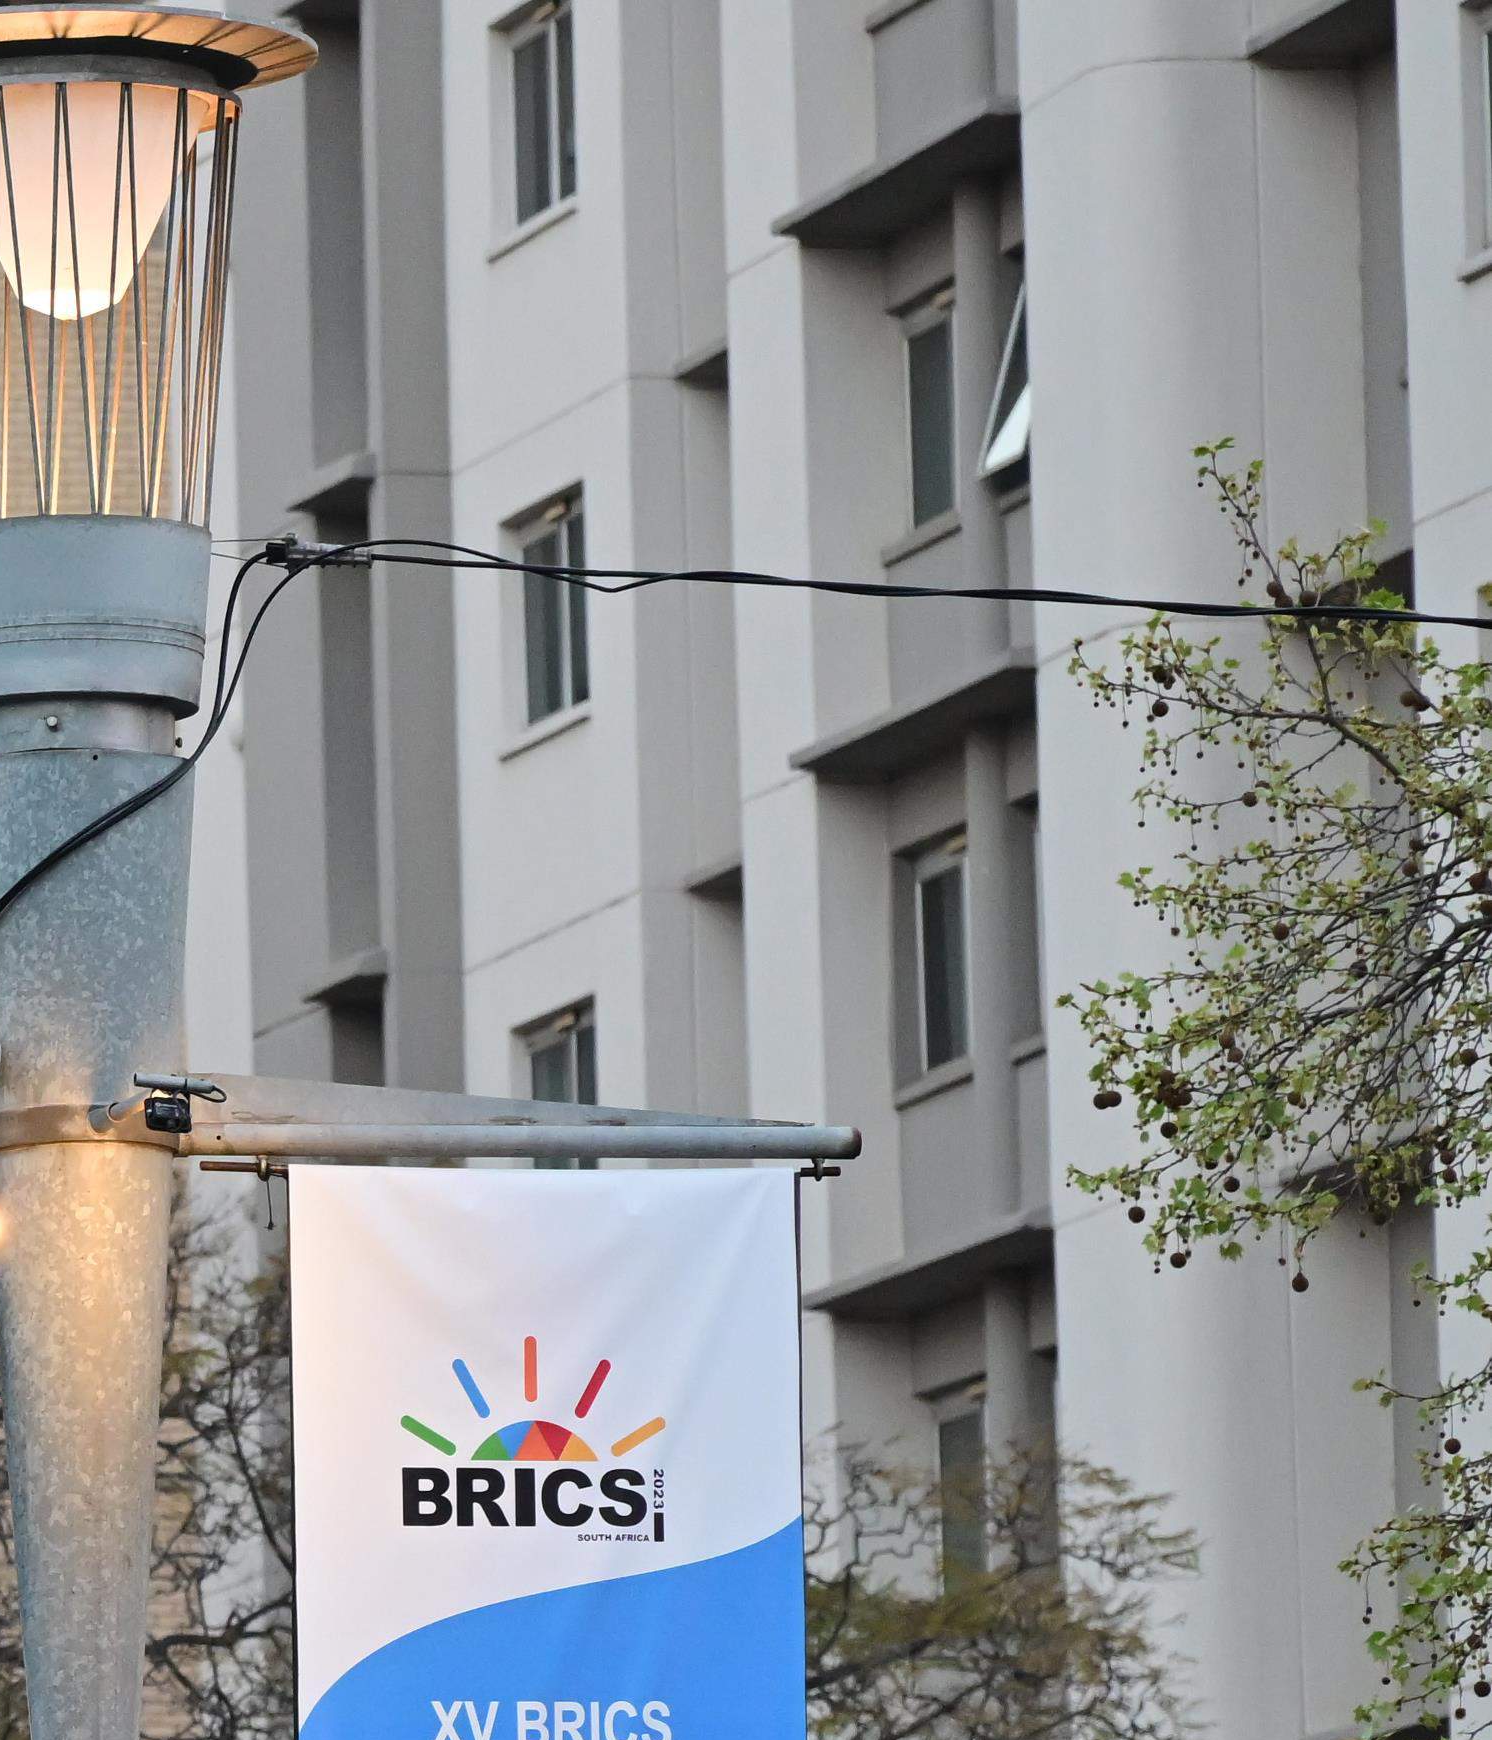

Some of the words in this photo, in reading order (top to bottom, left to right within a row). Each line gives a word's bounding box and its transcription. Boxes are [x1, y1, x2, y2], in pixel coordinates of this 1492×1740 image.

[401, 1467, 648, 1528] BRICS
[653, 1468, 665, 1510] 2023
[577, 1533, 612, 1542] SOUTH
[614, 1533, 650, 1542] AFRICA
